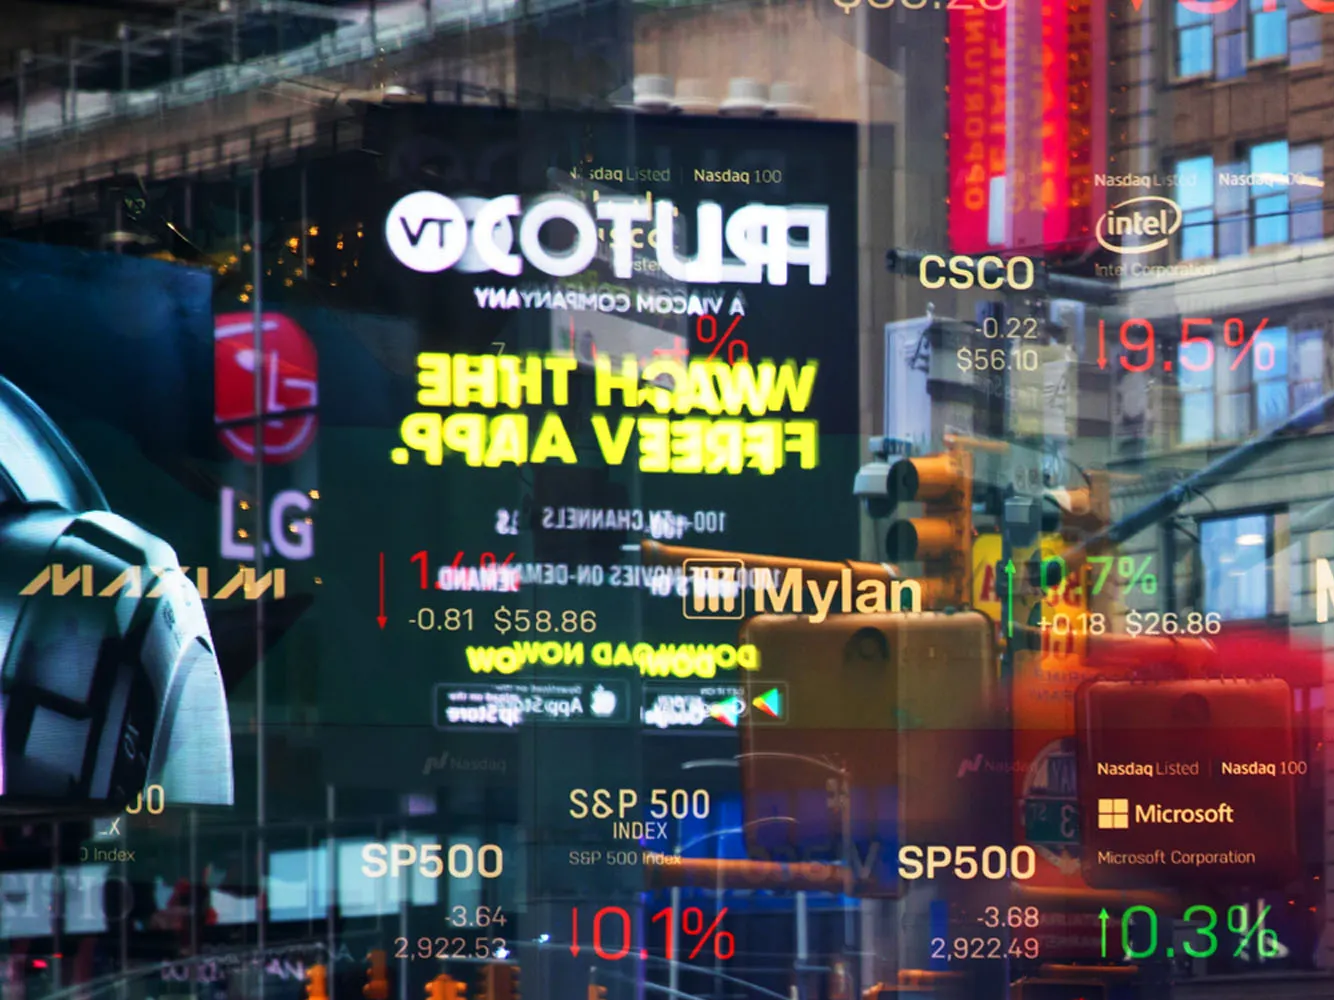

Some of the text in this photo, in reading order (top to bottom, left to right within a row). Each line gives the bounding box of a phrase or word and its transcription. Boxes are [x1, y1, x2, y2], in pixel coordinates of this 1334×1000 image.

[626, 168, 671, 183] Listed
[694, 168, 783, 186] Nasdaq 100
[1094, 172, 1152, 190] Nasdaq
[1107, 209, 1168, 236] intel
[919, 254, 1035, 290] CSCO
[1094, 262, 1124, 277] Intel
[975, 317, 1039, 340] -0.22
[1120, 317, 1276, 372] 9.5%
[955, 347, 1039, 374] $56.10
[219, 486, 316, 561] LG
[19, 563, 286, 601] MAXIM
[1039, 555, 1158, 596] 0.7%
[753, 567, 923, 624] Mylan
[408, 605, 598, 635] -0.81 $58.86
[1036, 609, 1222, 638] +0.18 $26.86
[1097, 762, 1153, 780] Nasdaq
[1156, 761, 1200, 777] Listed
[1221, 761, 1308, 780] Nasdaq 100
[569, 787, 712, 819] S&P 500
[1134, 802, 1234, 824] Microsoft
[612, 821, 669, 841] INDEX
[93, 847, 136, 864] Index
[360, 843, 504, 879] SP500
[569, 850, 683, 866] S&P 500 Index
[897, 844, 1037, 881] SP500
[1097, 850, 1256, 868] Microsoft Corporation
[444, 904, 508, 928] -3.64
[976, 905, 1040, 929] -3.68
[592, 903, 737, 960] 0.1%
[1120, 903, 1281, 960] 0.3%
[930, 936, 1040, 962] 2,922.49
